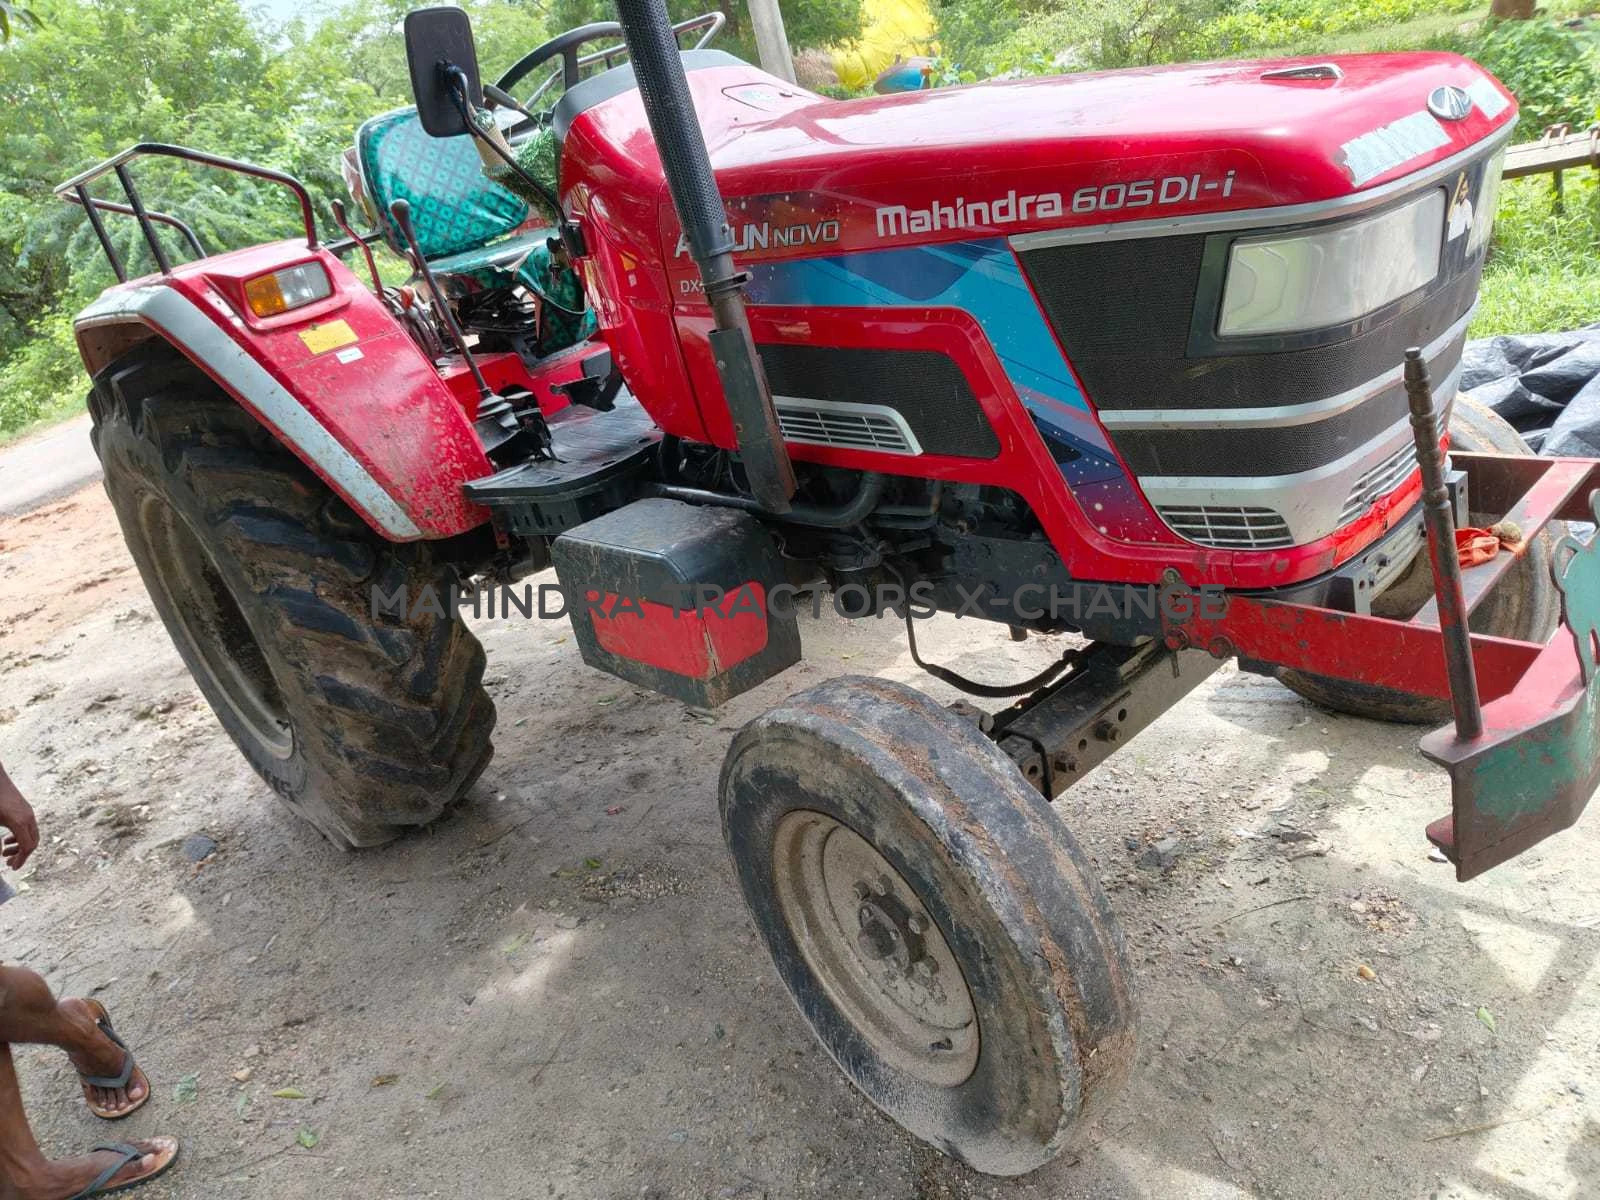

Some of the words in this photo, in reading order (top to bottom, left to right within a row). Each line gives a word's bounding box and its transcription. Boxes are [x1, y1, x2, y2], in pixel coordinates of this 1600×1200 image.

[876, 189, 1063, 238] Mahindra
[674, 222, 769, 258] AUN
[772, 220, 840, 249] NOVO
